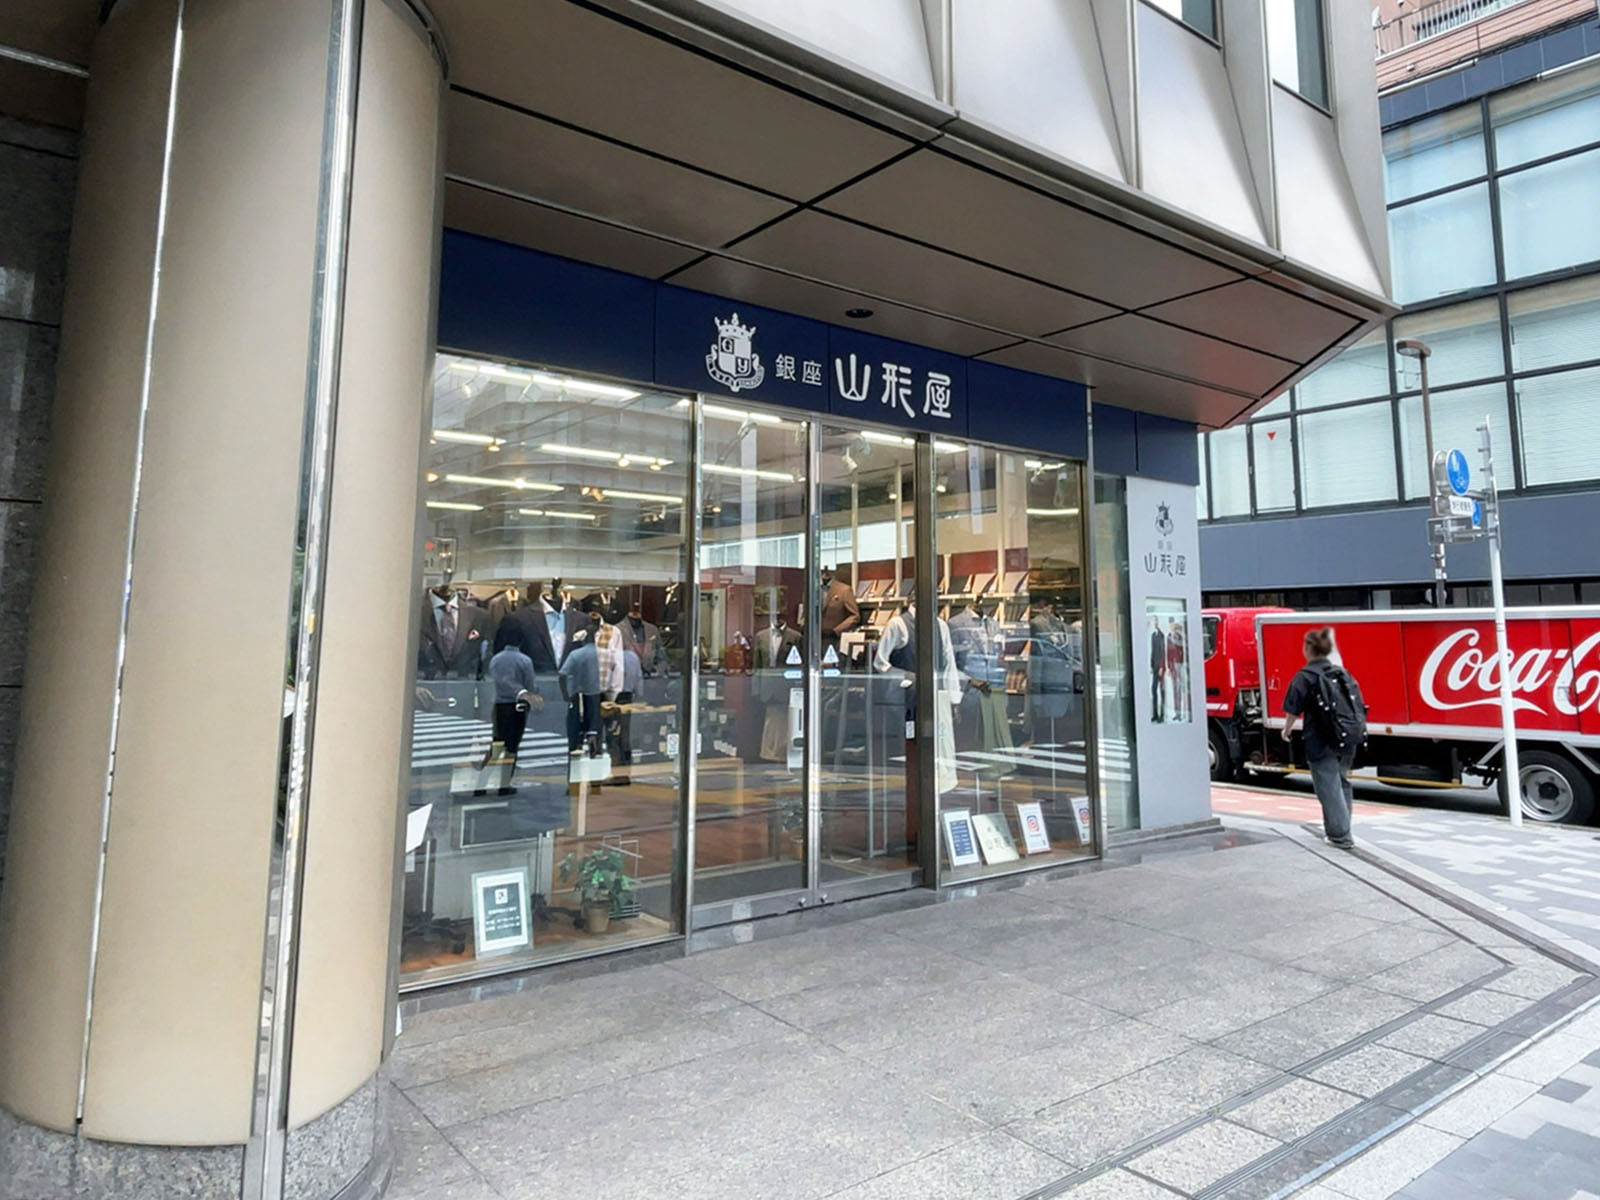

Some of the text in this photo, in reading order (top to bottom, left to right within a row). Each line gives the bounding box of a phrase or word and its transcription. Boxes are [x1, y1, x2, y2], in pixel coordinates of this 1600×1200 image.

[774, 353, 823, 387] 銀座
[834, 352, 953, 419] 山形屋
